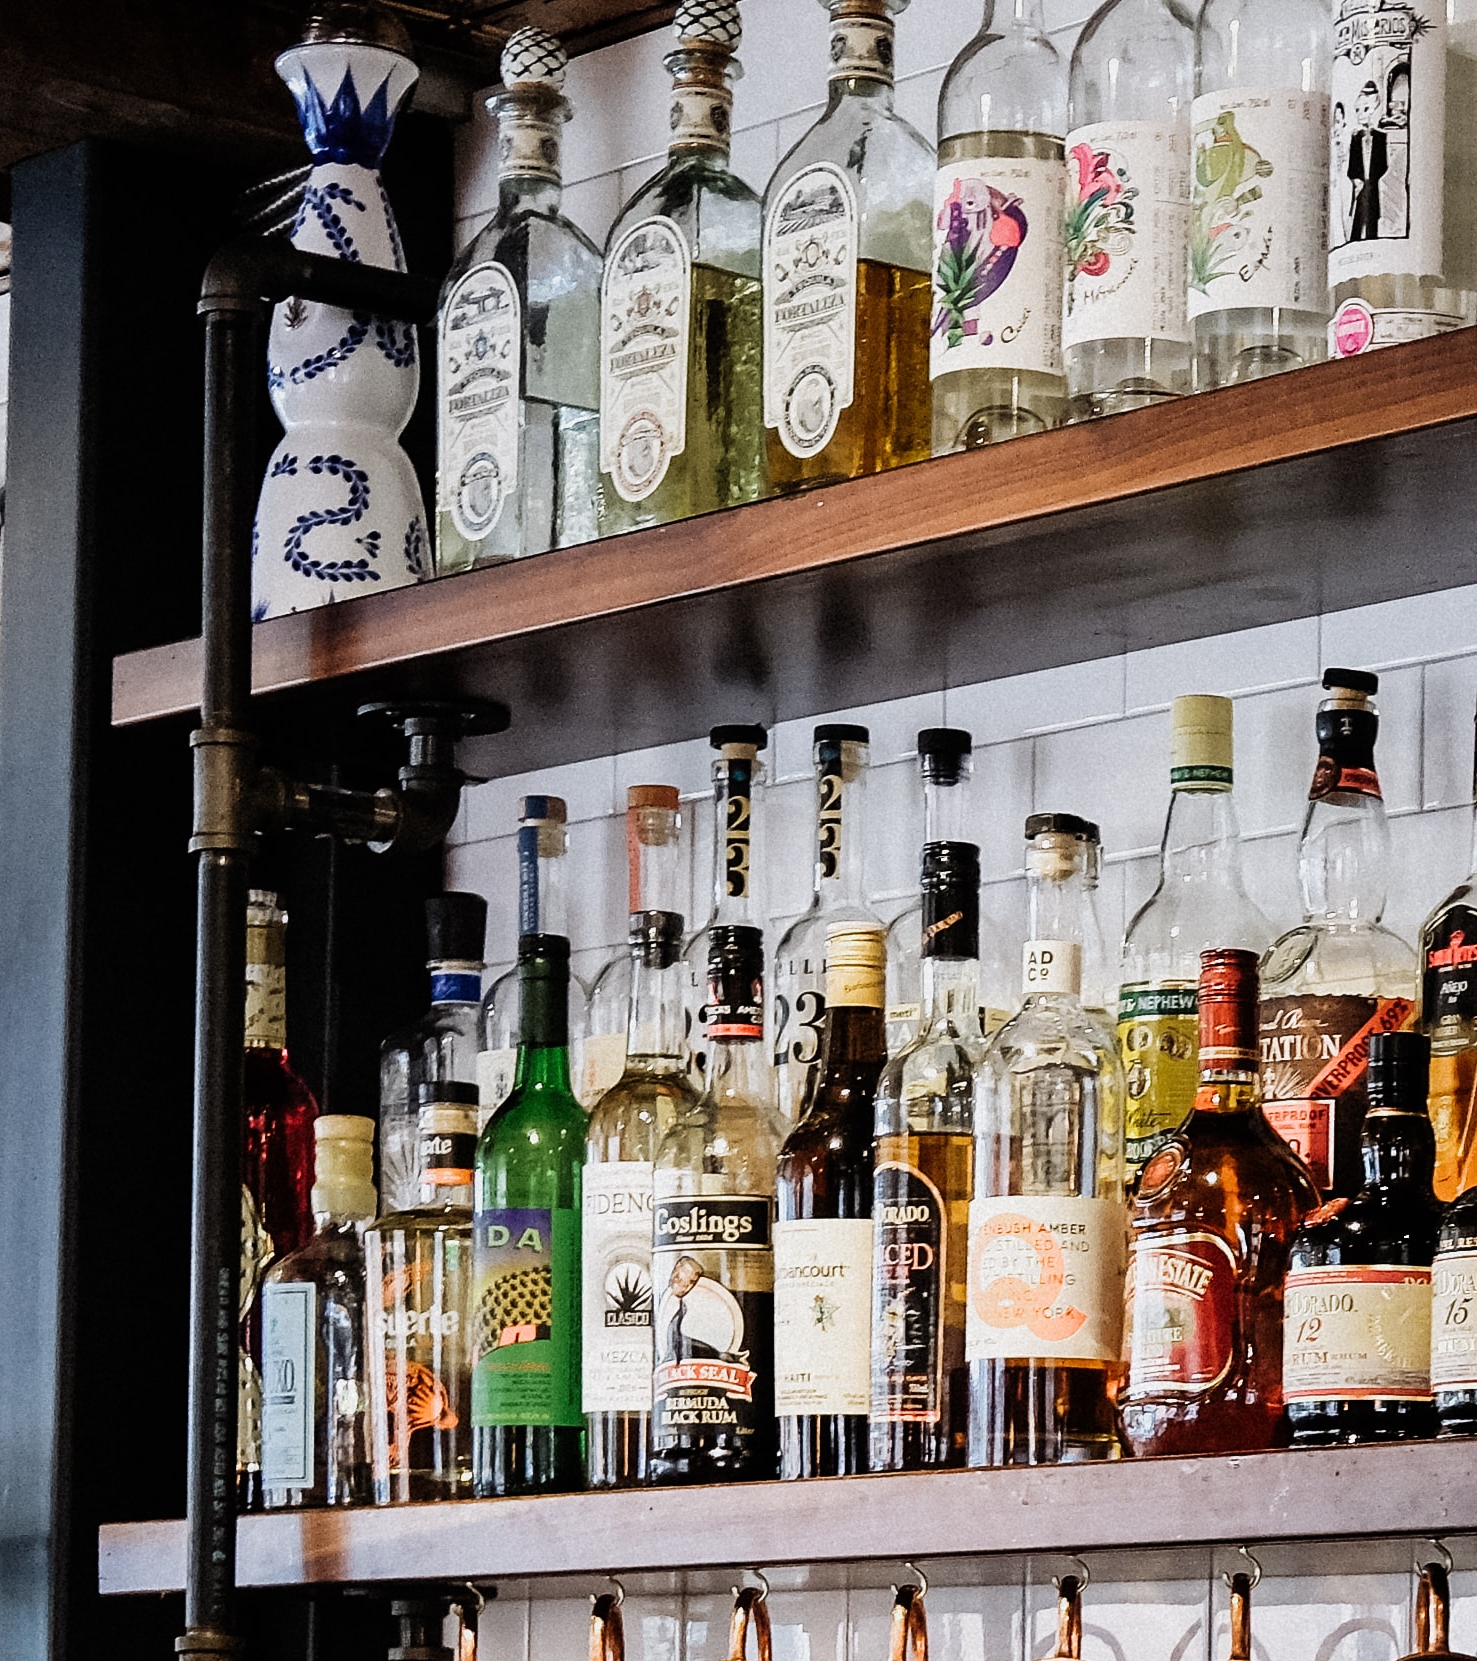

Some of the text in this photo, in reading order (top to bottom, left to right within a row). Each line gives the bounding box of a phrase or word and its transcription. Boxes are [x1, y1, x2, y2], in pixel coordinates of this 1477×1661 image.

[1351, 15, 1407, 40] MISERIOS
[1027, 948, 1054, 966] AD
[1137, 993, 1197, 1010] NEPHEW
[1266, 1108, 1327, 1122] ERPROOF
[656, 1207, 754, 1242] Goslings
[983, 1222, 1087, 1236] ENBUSH AMBER
[1060, 1240, 1092, 1253] AND
[883, 1242, 935, 1271] CED
[1026, 1256, 1057, 1268] THE
[1034, 1306, 1075, 1320] YORK
[1443, 1297, 1474, 1326] 15
[1296, 1317, 1323, 1344] 12
[600, 1349, 651, 1364] MEZCA
[1291, 1351, 1329, 1366] RUM
[699, 1365, 740, 1382] SEAL
[666, 1397, 730, 1411] BERMUDA
[701, 1409, 738, 1425] RUM
